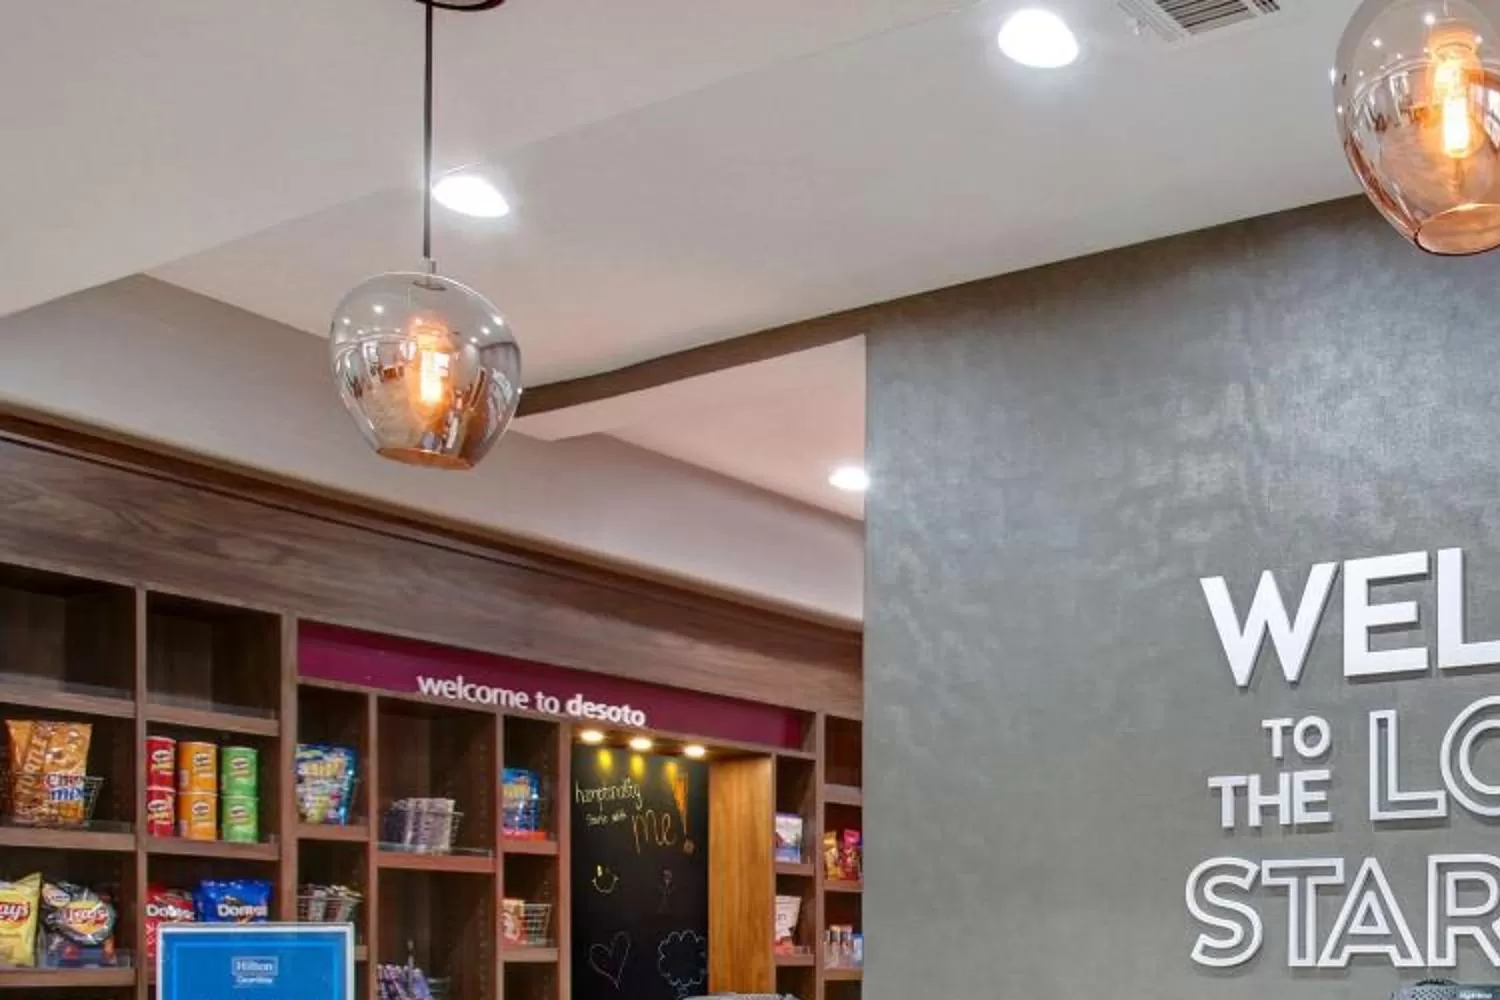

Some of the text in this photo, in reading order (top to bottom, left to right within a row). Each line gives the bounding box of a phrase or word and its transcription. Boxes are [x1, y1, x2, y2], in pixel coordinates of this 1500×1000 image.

[416, 674, 646, 727] welcome to desoto
[1262, 715, 1330, 758] TO
[1208, 770, 1332, 827] THE
